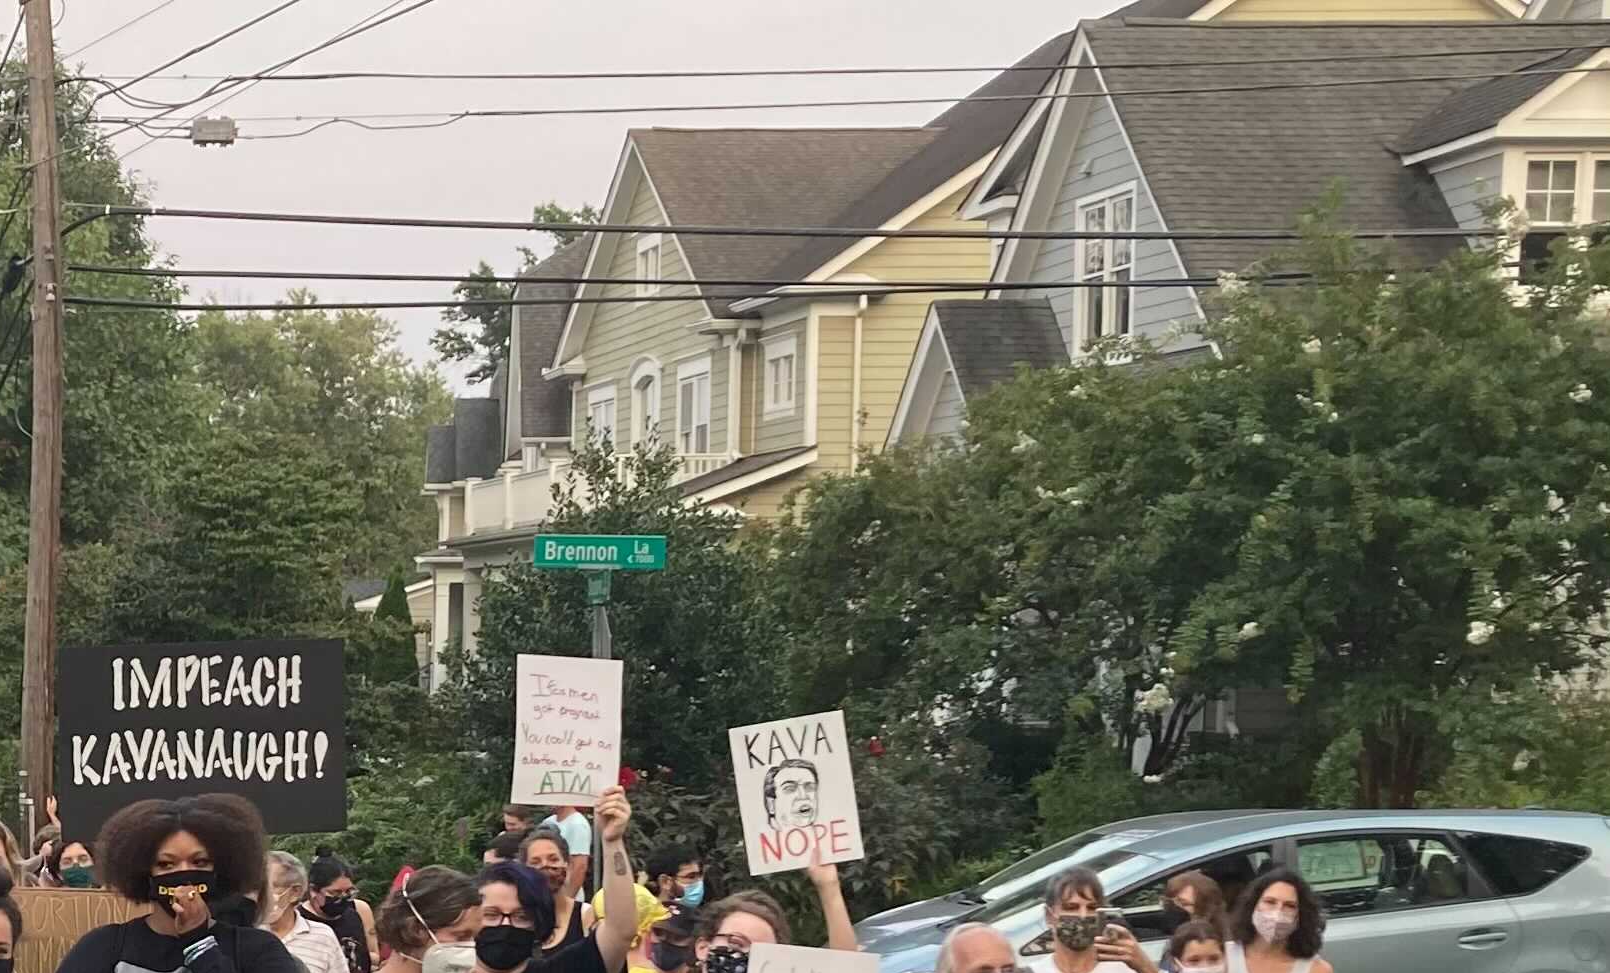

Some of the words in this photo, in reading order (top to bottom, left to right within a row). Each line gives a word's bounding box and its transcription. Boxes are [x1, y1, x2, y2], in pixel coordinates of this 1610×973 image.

[544, 540, 618, 561] Brennon
[634, 540, 650, 554] La
[111, 654, 302, 711] IMPEACH
[71, 726, 329, 786] KAVANAUGH!
[743, 721, 834, 770] KAVA
[538, 770, 592, 794] ATM
[760, 819, 851, 864] NOPE
[19, 895, 131, 935] BORTION
